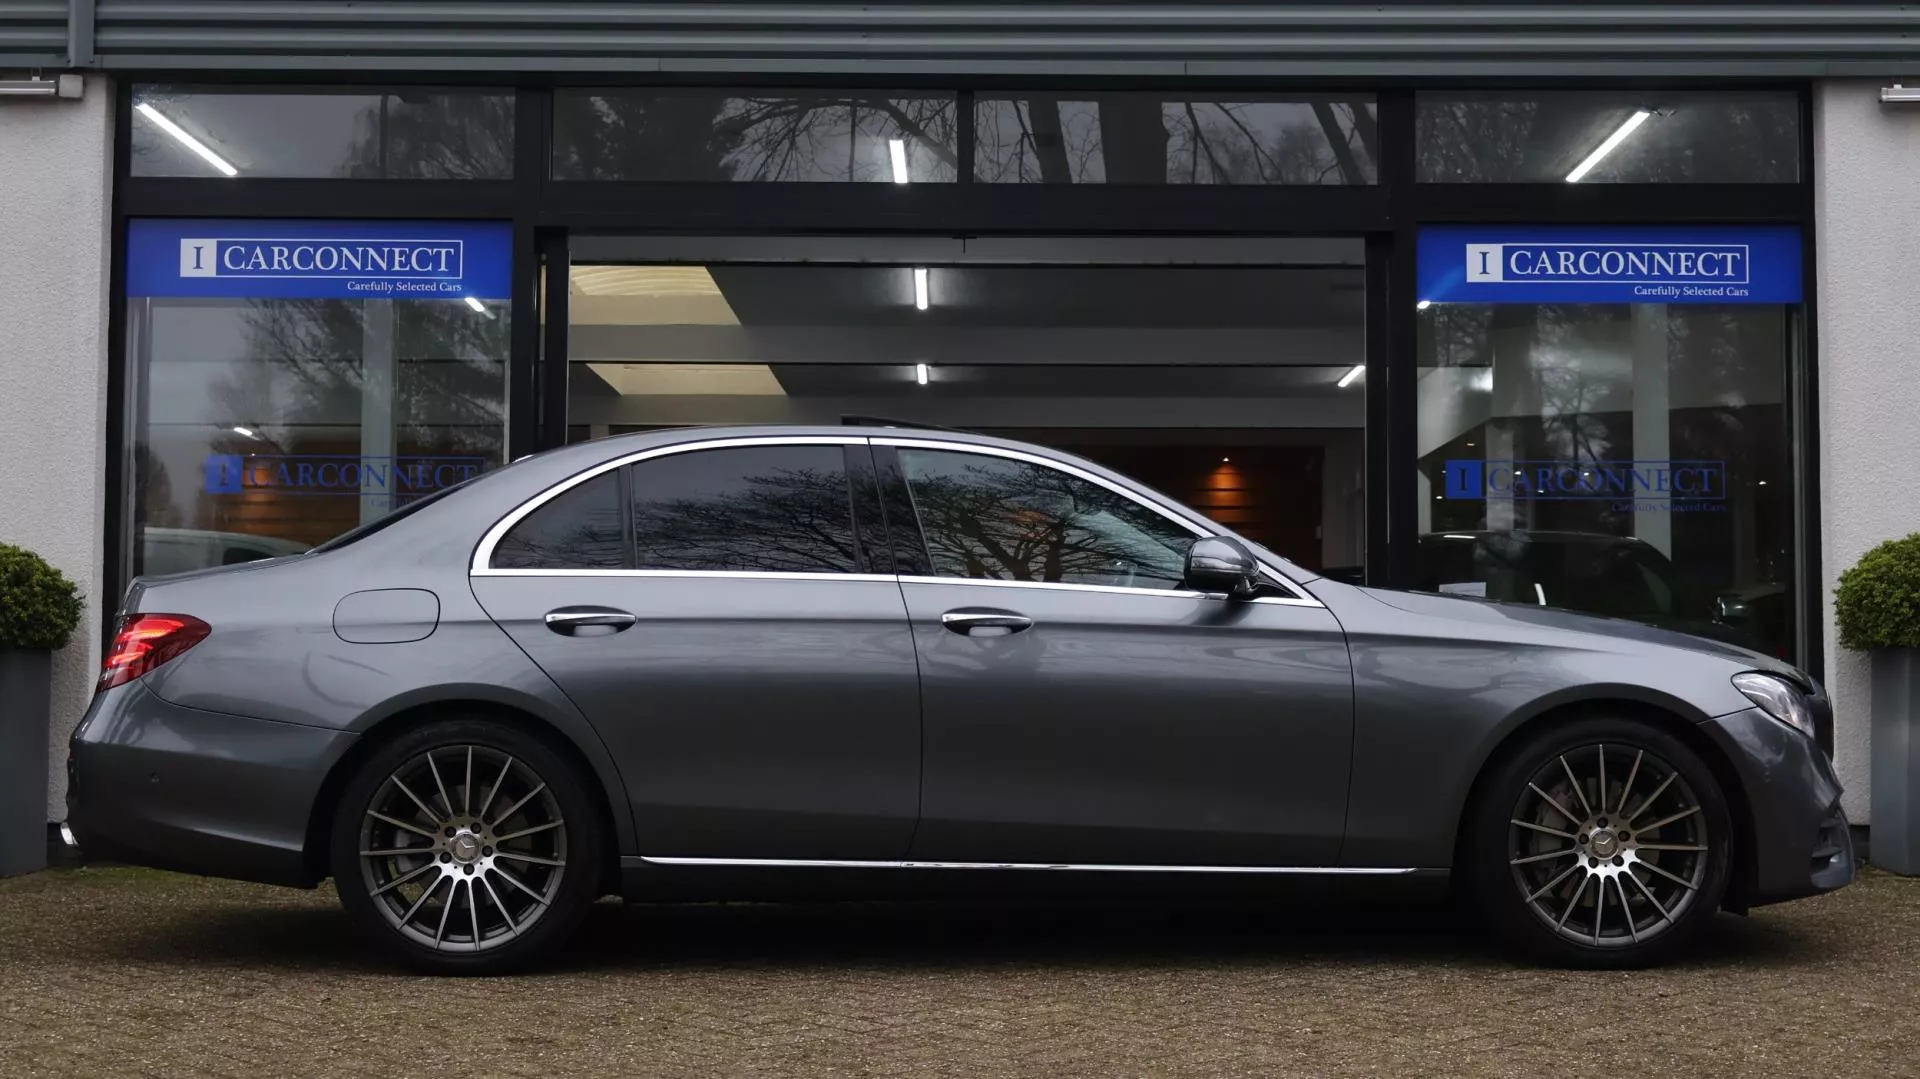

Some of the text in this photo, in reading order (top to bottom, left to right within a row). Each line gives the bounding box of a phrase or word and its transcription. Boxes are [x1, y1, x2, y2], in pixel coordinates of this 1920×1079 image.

[192, 245, 455, 272] I CARCONNECT
[1479, 250, 1741, 277] I CARCONNECT
[347, 280, 462, 292] Carefully Selected Cars
[1634, 285, 1749, 298] Carefully Selected Cars
[250, 461, 479, 489] CARCONNECT
[1457, 467, 1718, 493] I CARCONNECT
